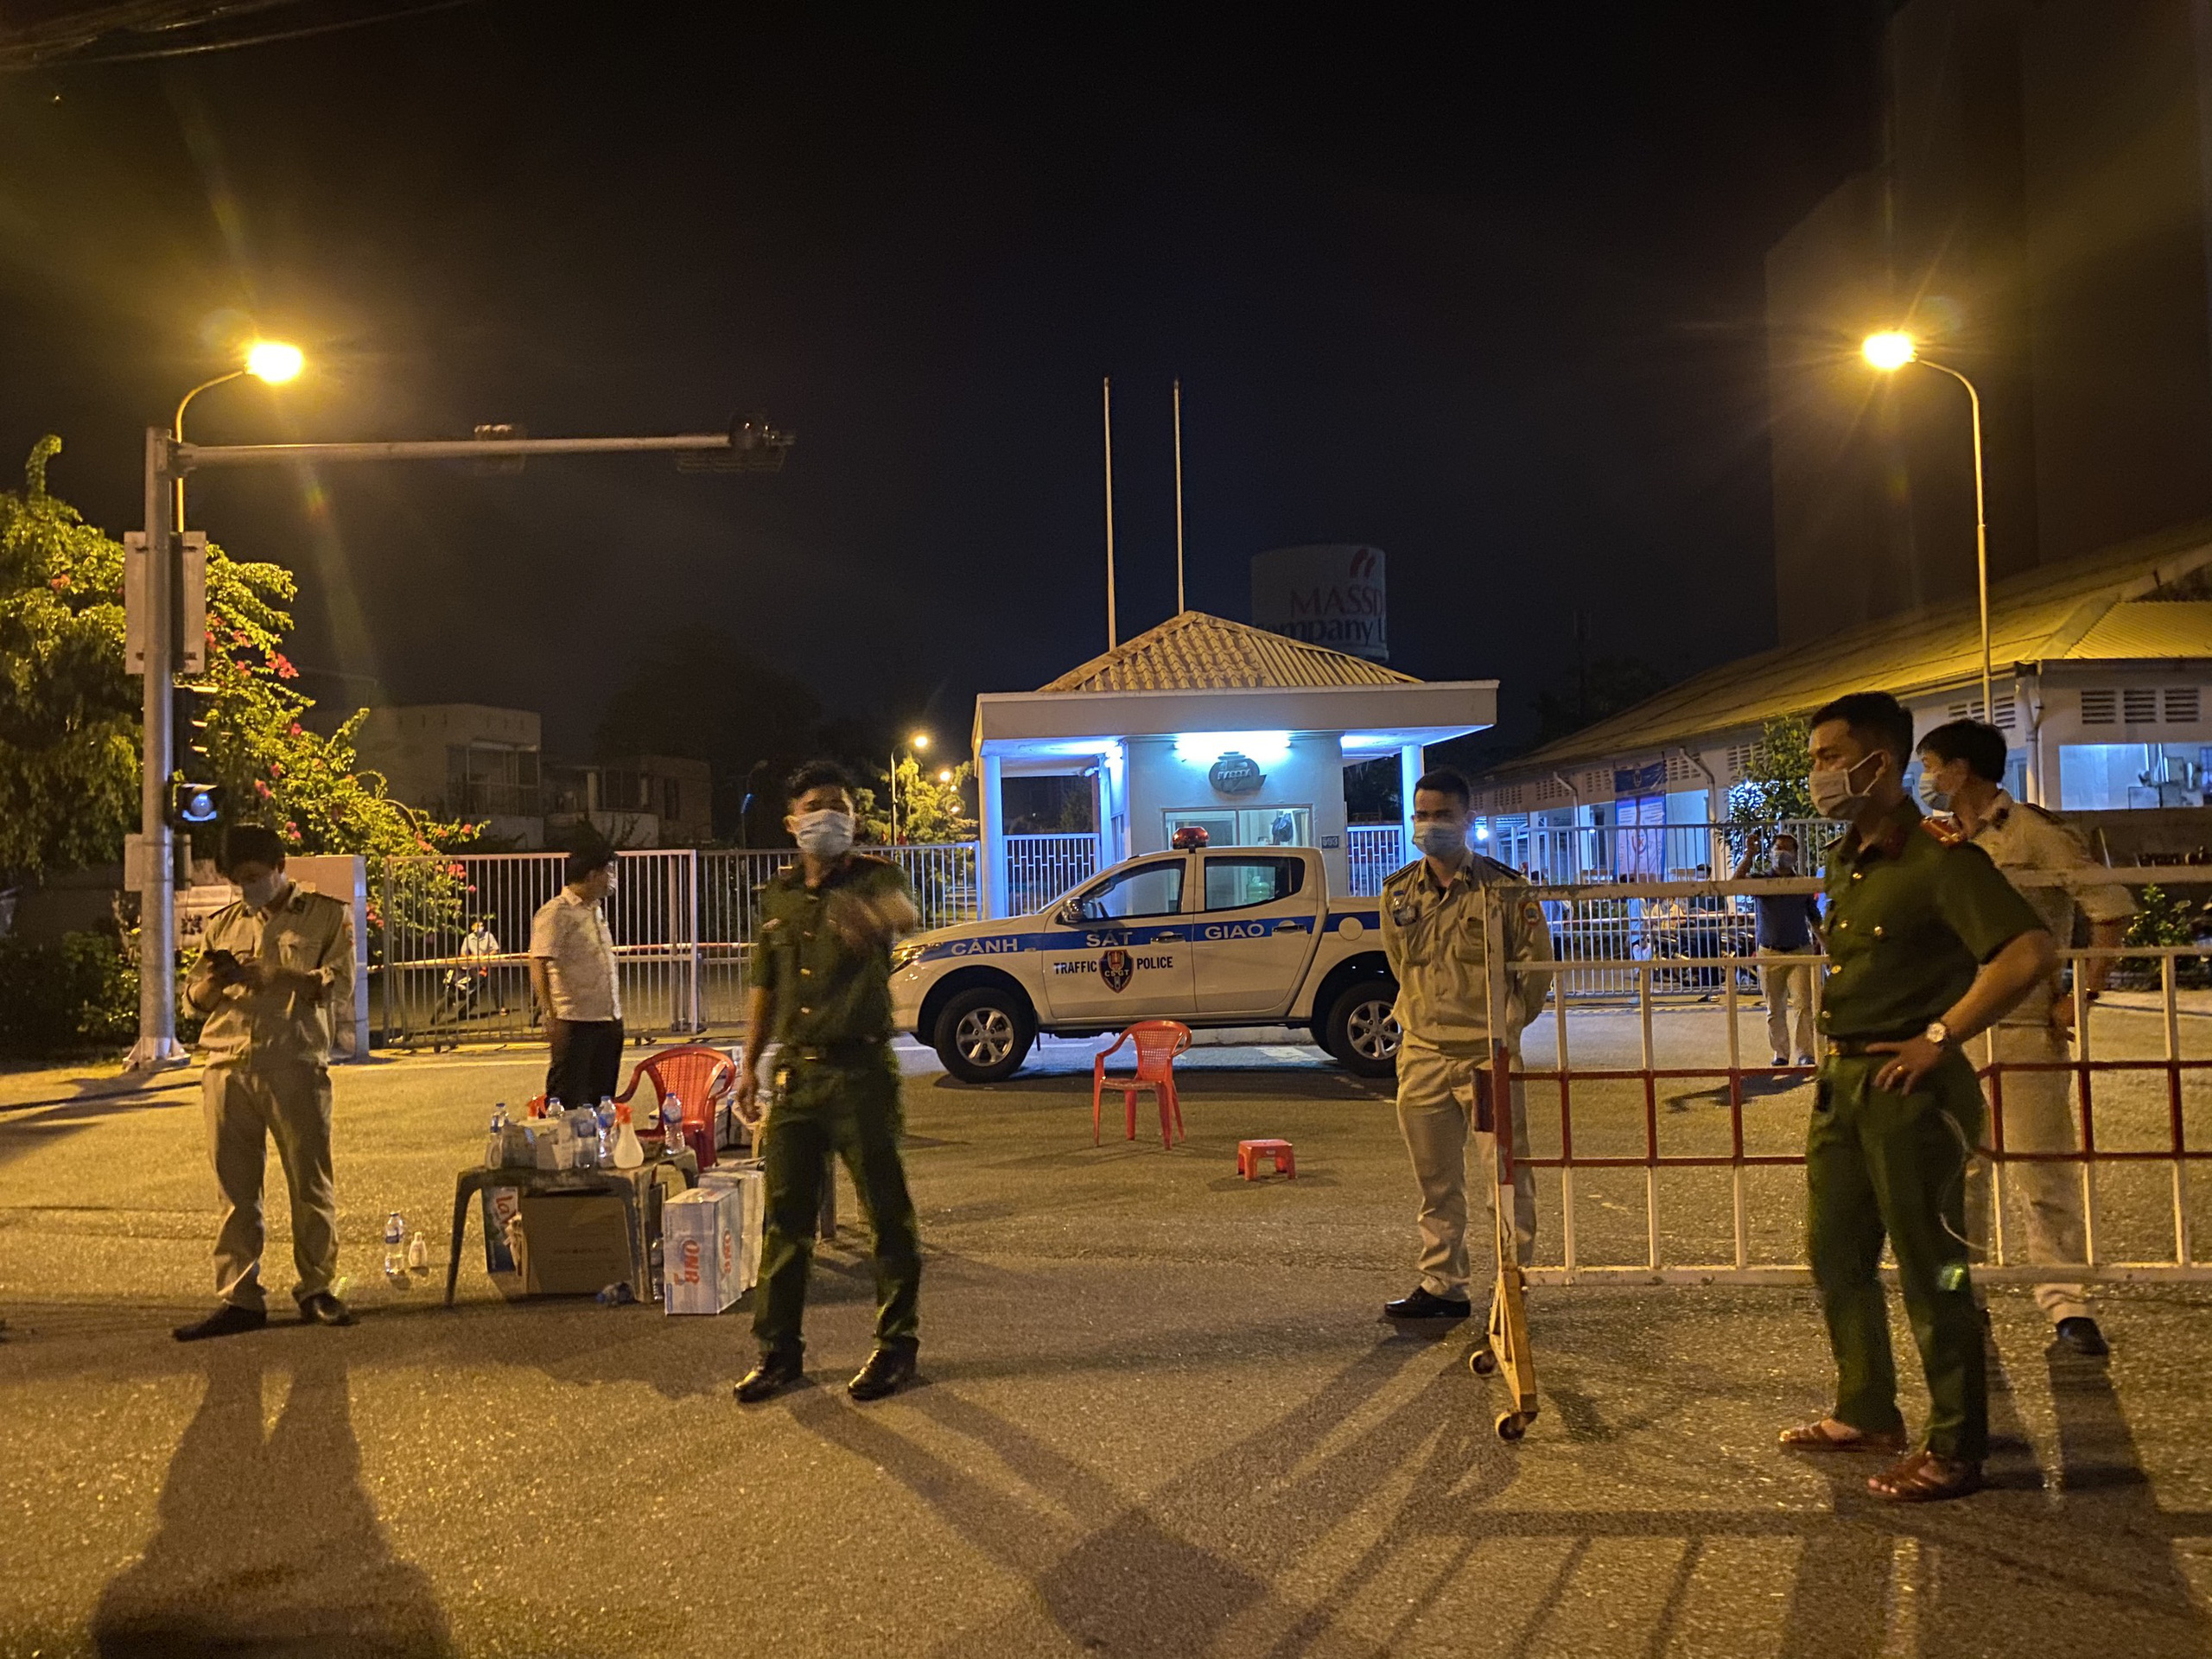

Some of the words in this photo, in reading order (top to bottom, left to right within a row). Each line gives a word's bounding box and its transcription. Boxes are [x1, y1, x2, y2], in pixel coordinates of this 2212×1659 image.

[951, 938, 1018, 956] CẢNH
[1086, 930, 1133, 947] SÁT
[1205, 924, 1265, 940] GIAO
[1053, 961, 1097, 975] TRAFFIC
[1136, 957, 1173, 969] POLICE
